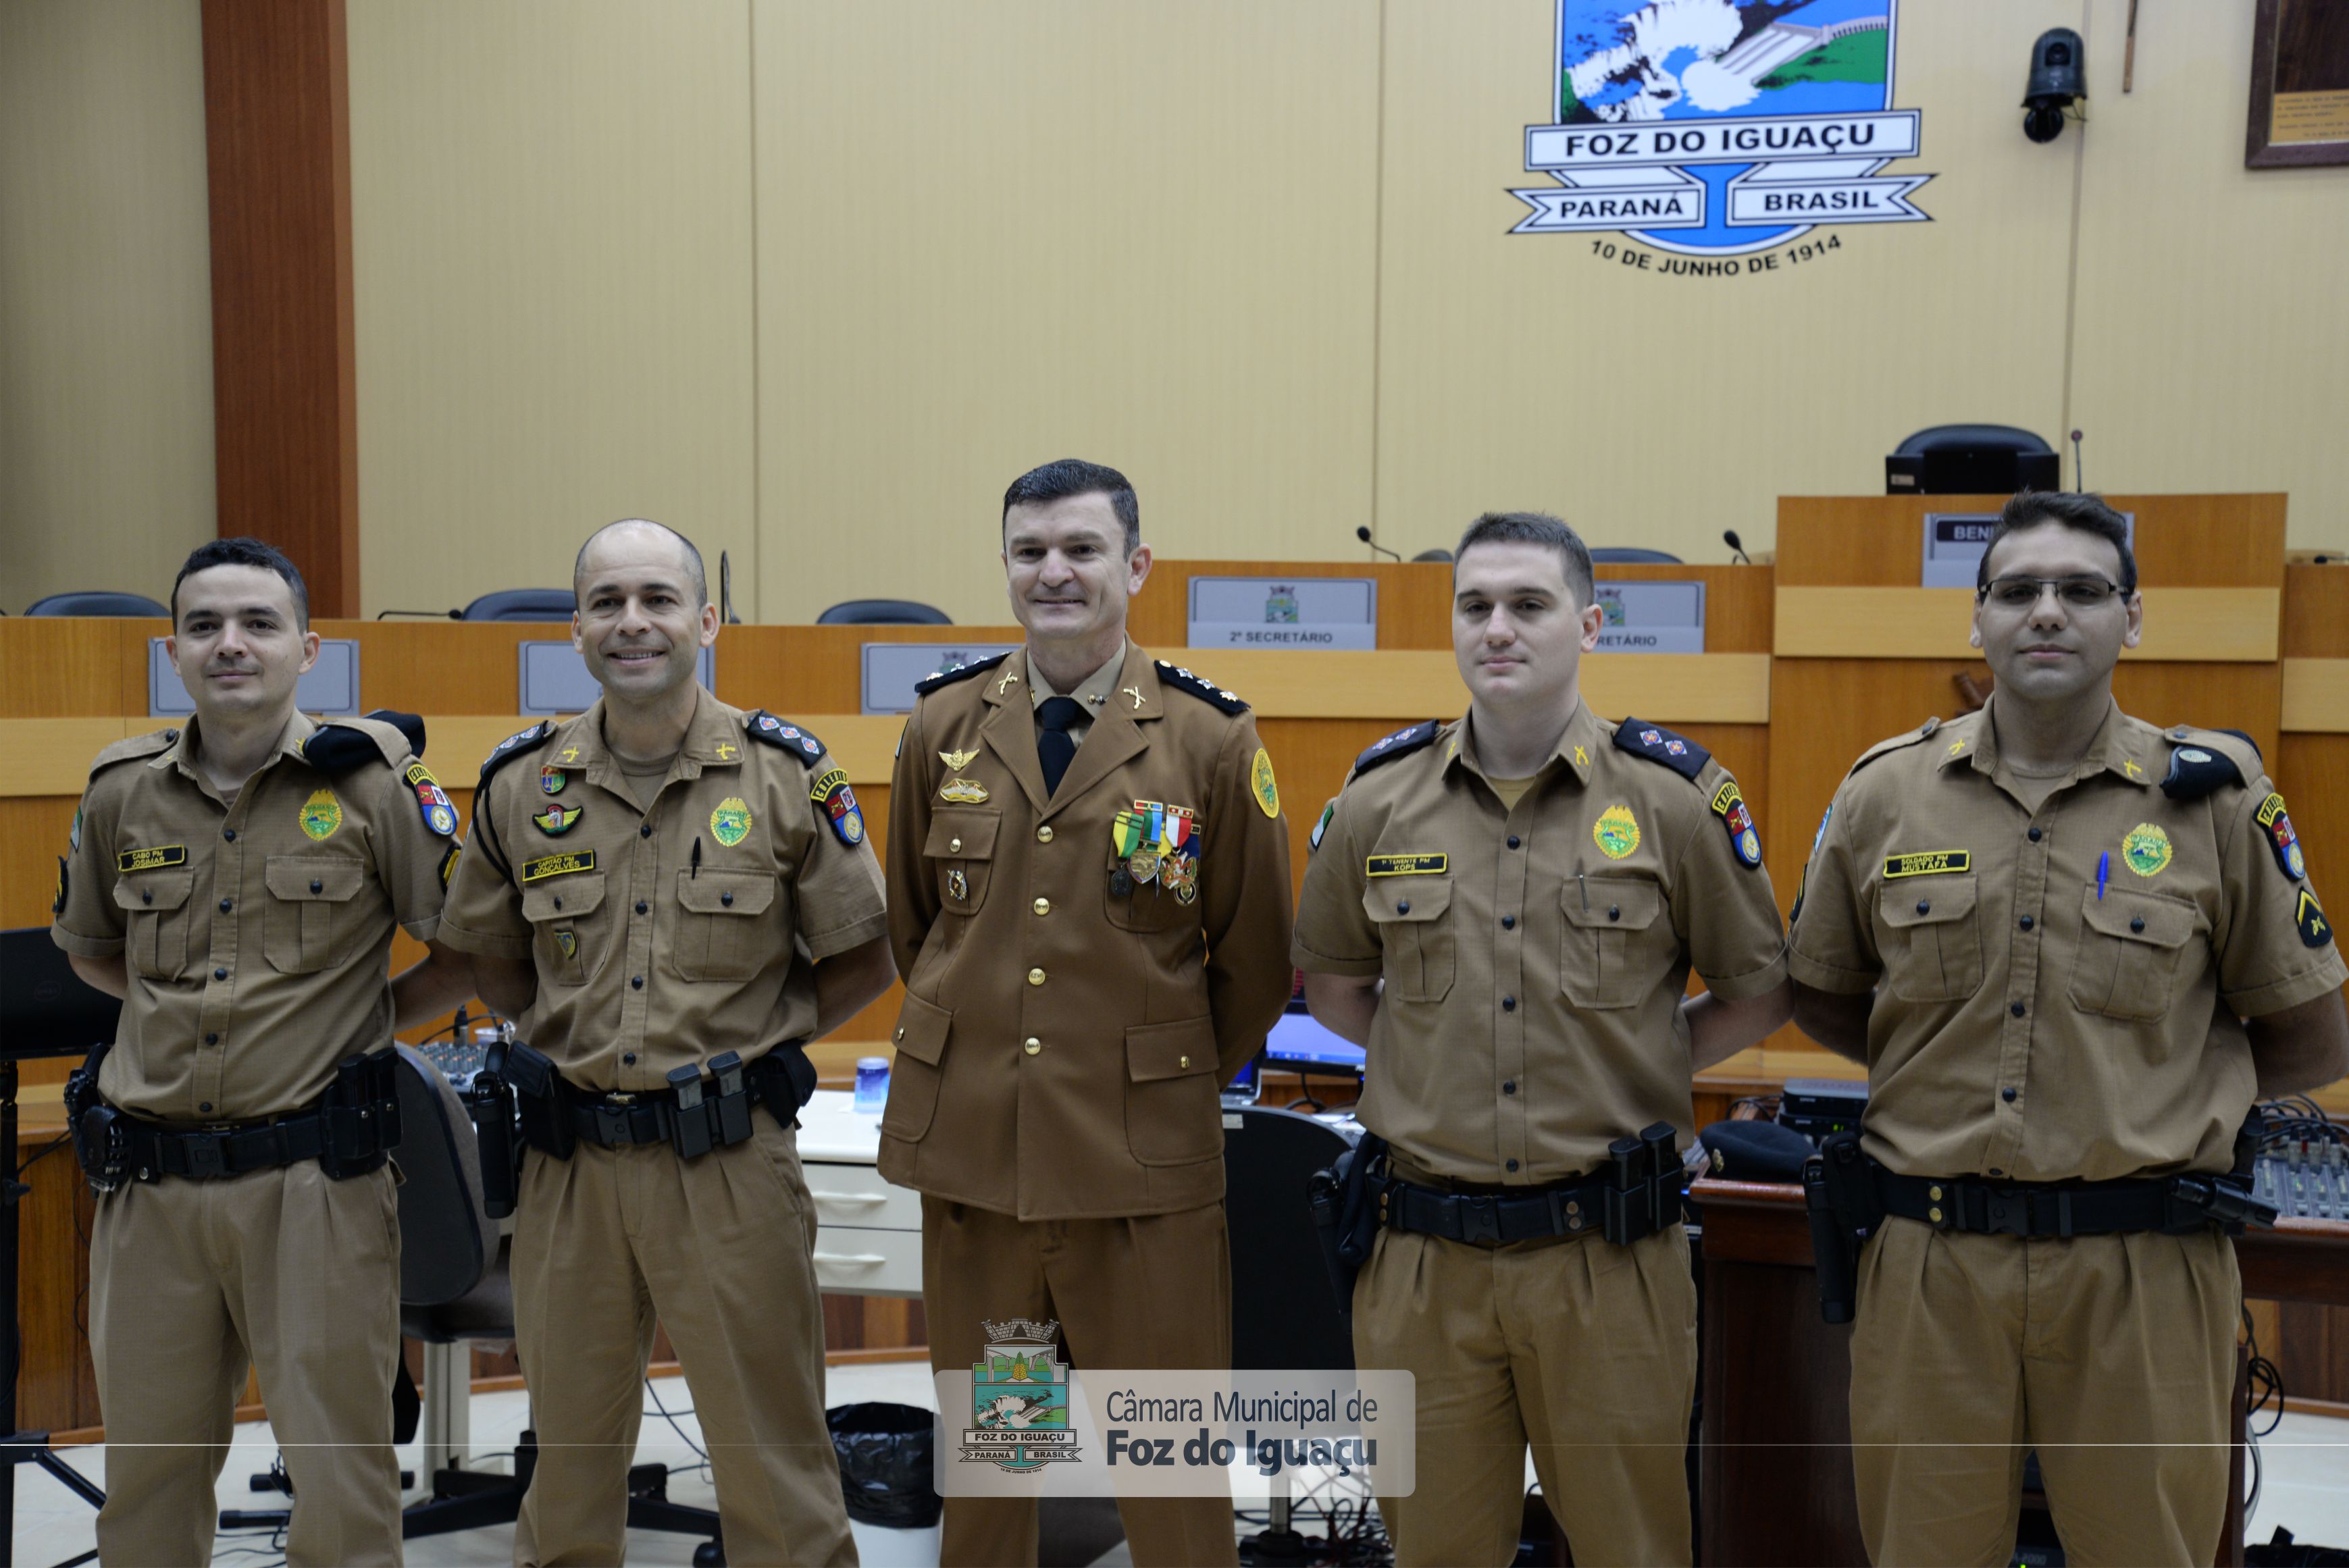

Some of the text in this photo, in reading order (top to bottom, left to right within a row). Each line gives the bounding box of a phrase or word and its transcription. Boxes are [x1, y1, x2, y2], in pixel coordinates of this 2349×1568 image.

[1566, 124, 1875, 156] FOZ DO IGUAÇU
[1561, 192, 1683, 219] PARANÁ
[1764, 190, 1878, 211] BRASIL
[1591, 234, 1842, 277] 10 DE JUNHO DE 1914
[1246, 631, 1333, 644] SECRETÁRIO
[1597, 633, 1657, 646] RETÁRIO
[132, 857, 165, 867] JOSIMAR
[1901, 855, 1934, 865] SOLDADO
[1902, 861, 1947, 872] MUSTAFA
